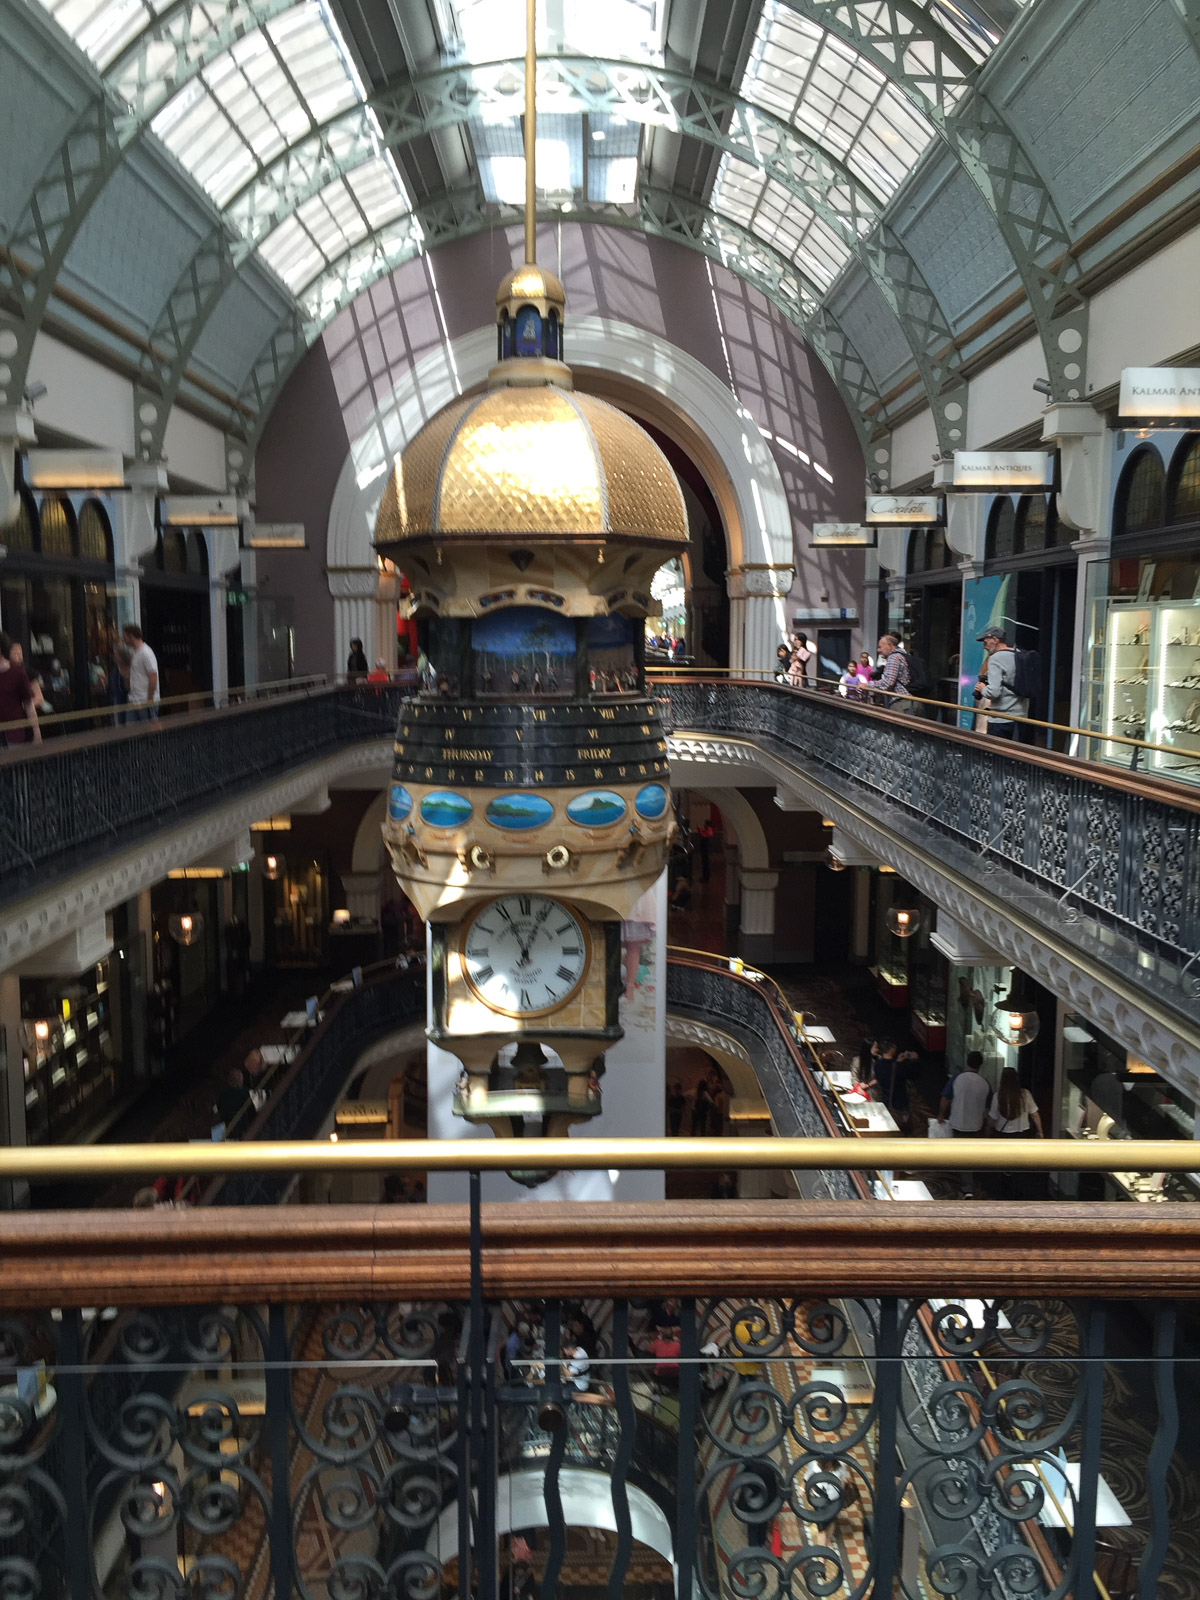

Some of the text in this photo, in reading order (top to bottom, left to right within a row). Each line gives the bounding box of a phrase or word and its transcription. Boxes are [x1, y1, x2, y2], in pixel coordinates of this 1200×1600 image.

[1132, 386, 1176, 396] KALMAR
[960, 464, 1033, 473] KALMAR ANTIQUES
[532, 709, 547, 721] VII
[599, 708, 616, 720] VIII
[587, 728, 599, 740] VI
[441, 748, 612, 762] THURSDAY FRIDAY
[504, 769, 514, 782] 13
[565, 769, 576, 781] 15
